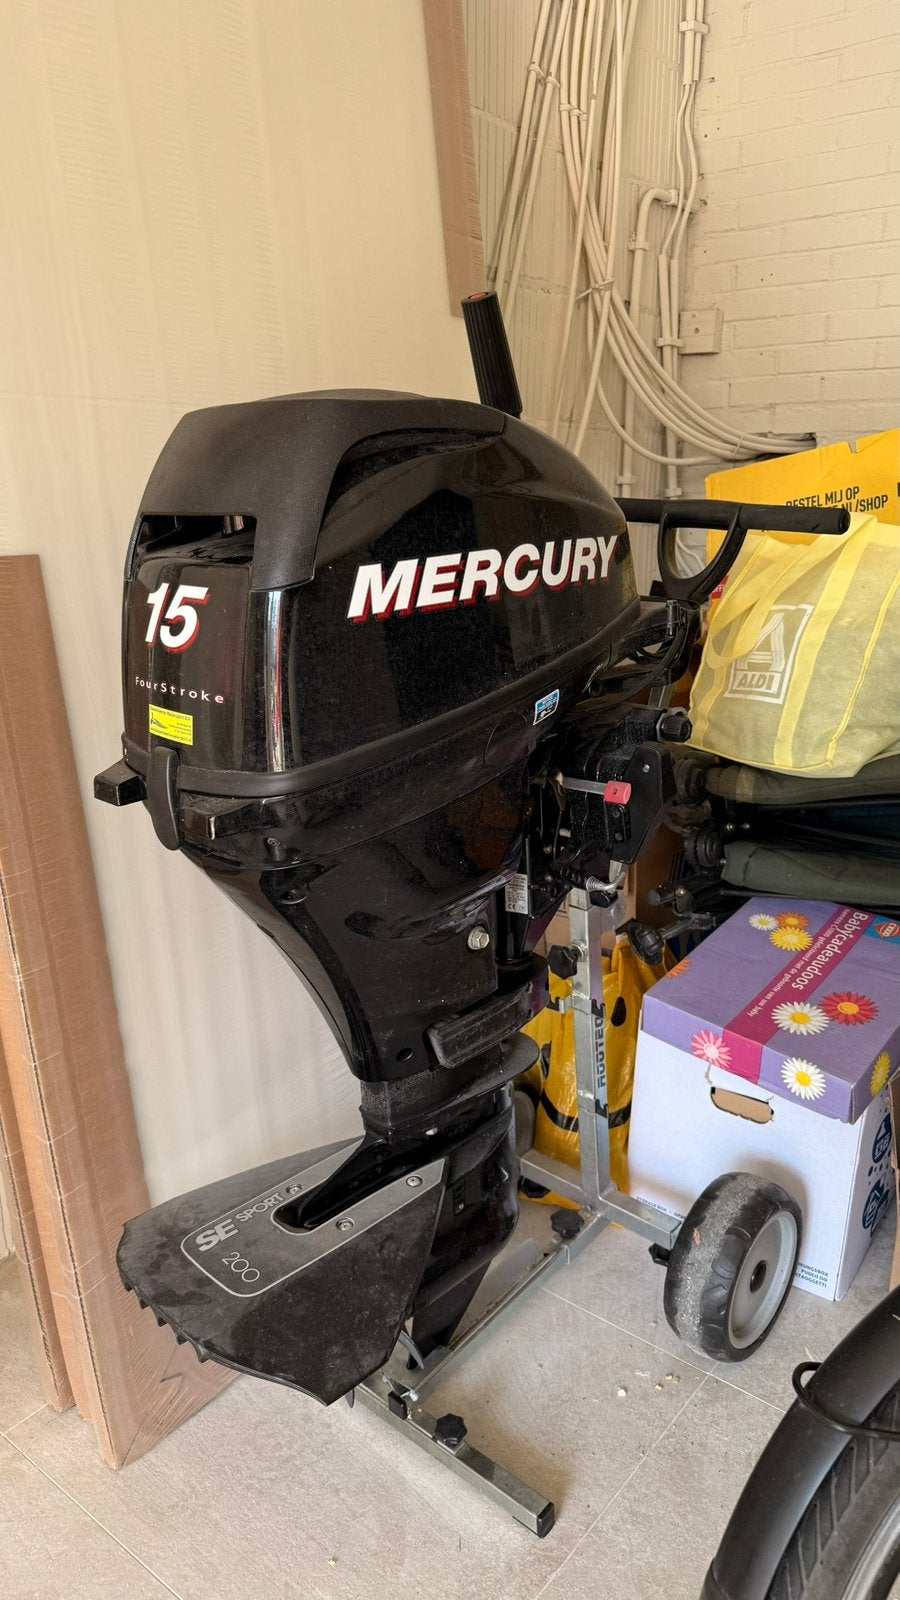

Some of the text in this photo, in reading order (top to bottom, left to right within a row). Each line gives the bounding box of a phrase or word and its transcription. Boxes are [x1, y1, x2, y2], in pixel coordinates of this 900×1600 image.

[825, 488, 842, 505] MIJ
[845, 486, 860, 501] OP
[347, 535, 618, 624] MERCURY
[145, 583, 211, 653] 15
[135, 676, 224, 704] FourStroke
[737, 673, 776, 691] ALDI
[791, 911, 869, 990] Babycadeaudoos
[789, 967, 798, 975] de
[795, 960, 805, 970] met
[774, 973, 792, 991] geboorte
[747, 1005, 762, 1017] baby
[195, 1192, 284, 1252] SE SPORT
[222, 1251, 260, 1283] 200
